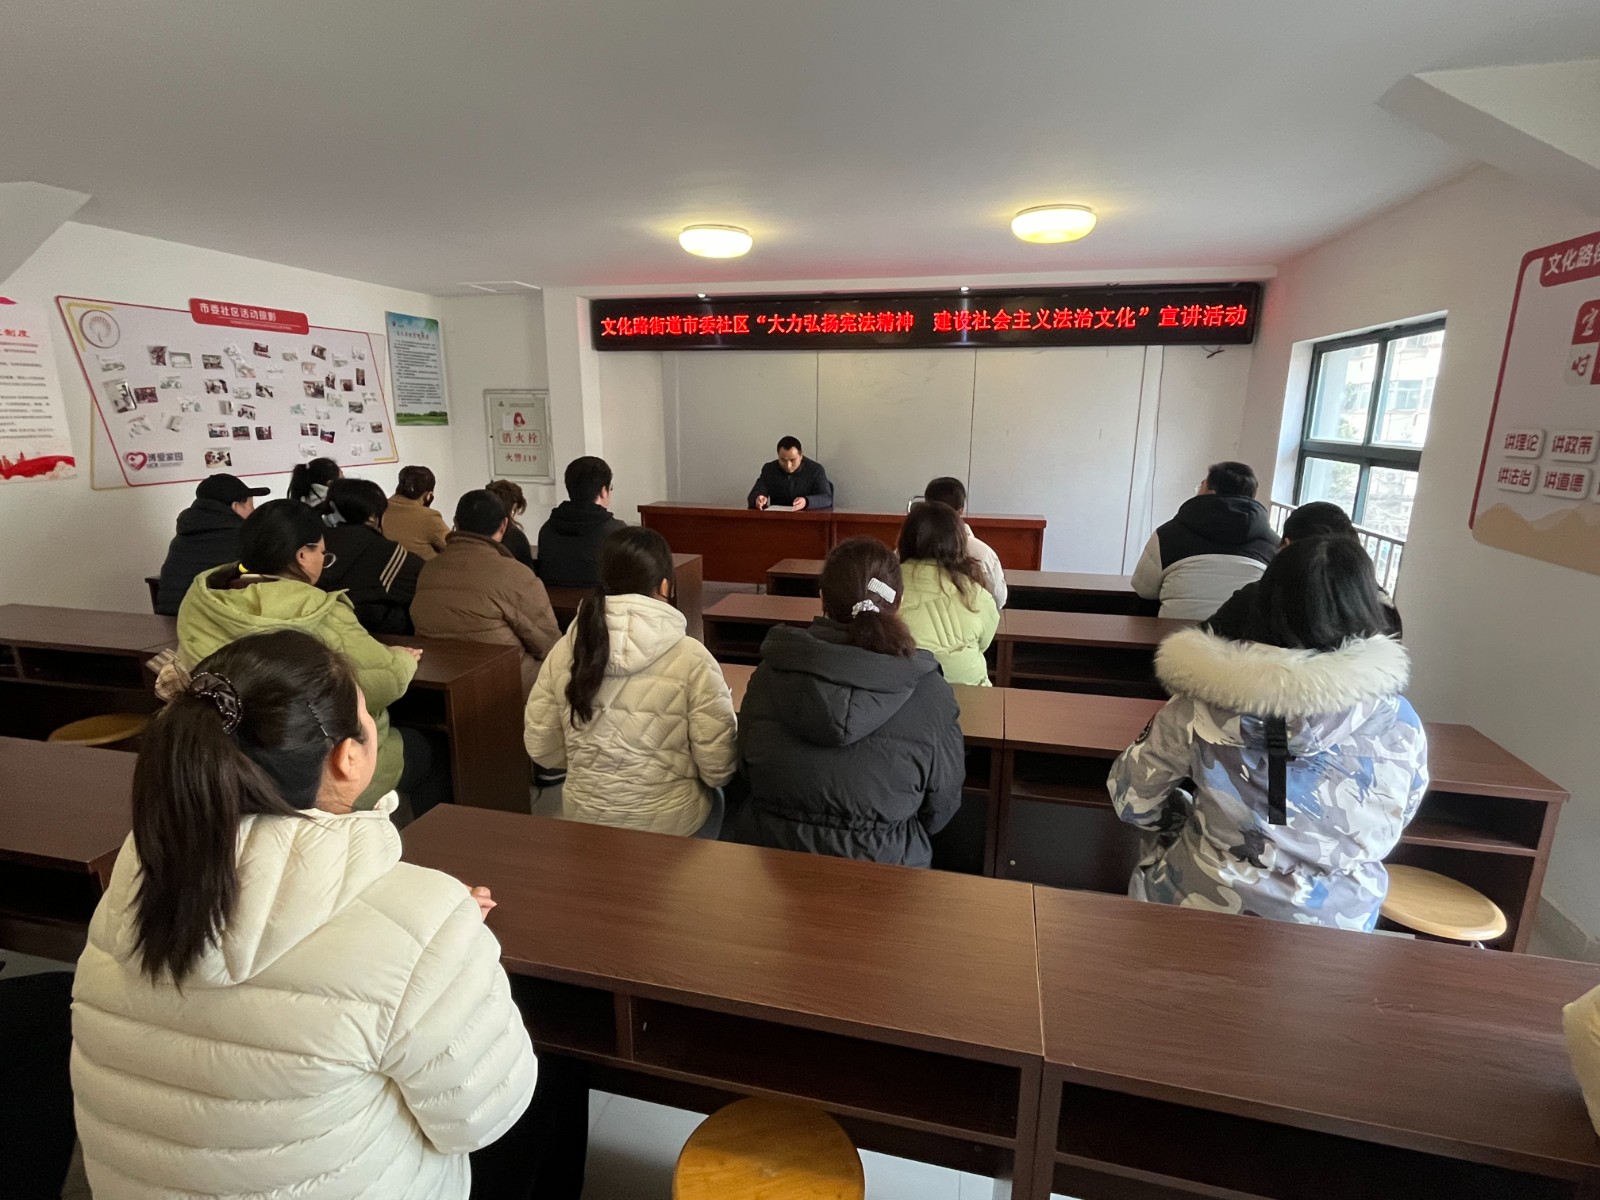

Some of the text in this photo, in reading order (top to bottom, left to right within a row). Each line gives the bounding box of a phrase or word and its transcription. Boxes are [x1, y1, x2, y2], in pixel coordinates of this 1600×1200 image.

[502, 431, 538, 444] 消火栓
[1503, 433, 1540, 452] 讲理论
[1551, 434, 1594, 455] 讲政策
[505, 453, 537, 462] 火警119
[1497, 466, 1532, 487] 讲法治
[1543, 471, 1585, 493] 讲道德
